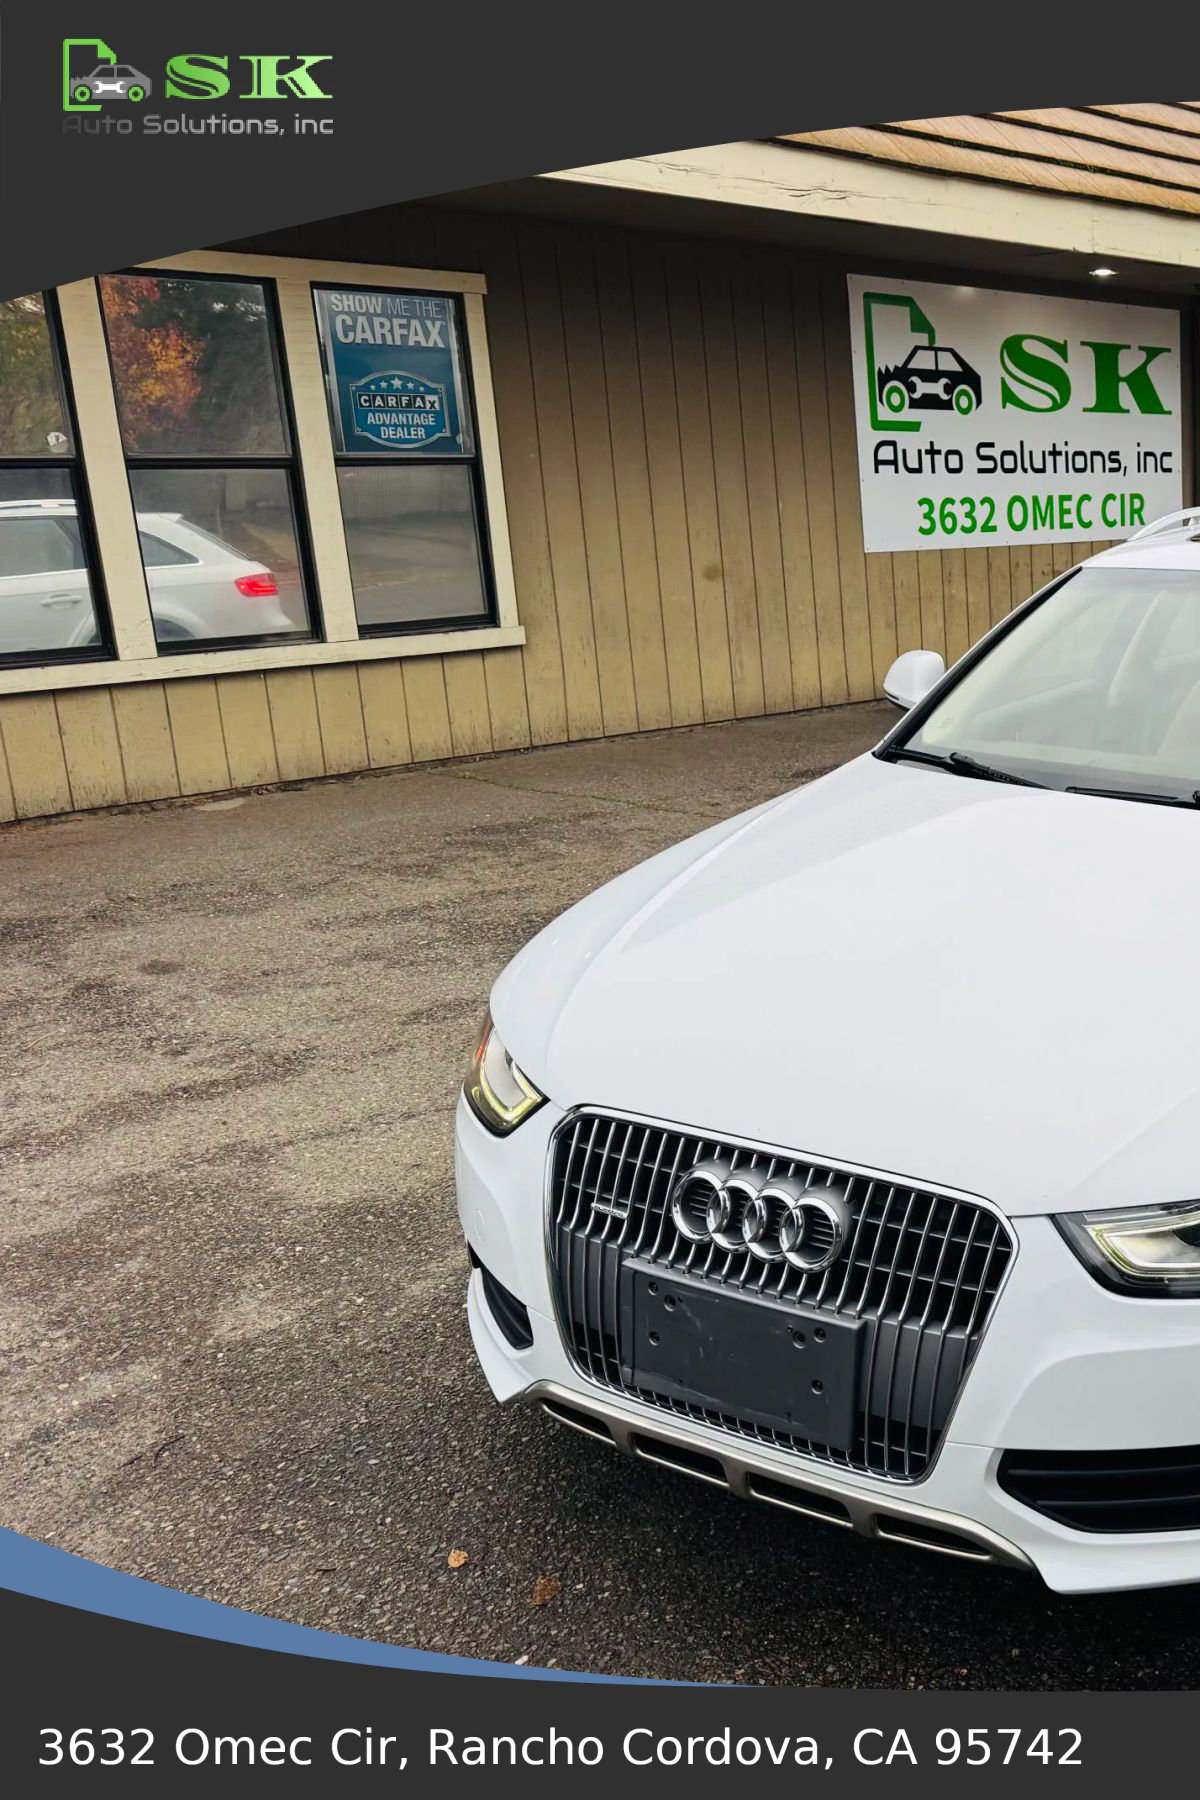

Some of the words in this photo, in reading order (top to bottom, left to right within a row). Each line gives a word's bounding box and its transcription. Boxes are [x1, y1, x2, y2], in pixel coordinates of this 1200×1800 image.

[331, 293, 382, 314] SHOW
[387, 298, 410, 316] ME
[413, 299, 442, 318] THE
[335, 314, 445, 348] CARFAX
[1000, 333, 1173, 415] SK
[359, 394, 439, 410] CARFAX
[367, 412, 436, 426] ADVANTAGE
[381, 427, 426, 439] DEALER
[873, 440, 964, 475] Auto
[976, 440, 1128, 476] Solutions,
[1137, 442, 1173, 474] inc
[917, 496, 998, 536] 3632
[1006, 494, 1093, 531] OMEC
[1101, 493, 1146, 527] CIR
